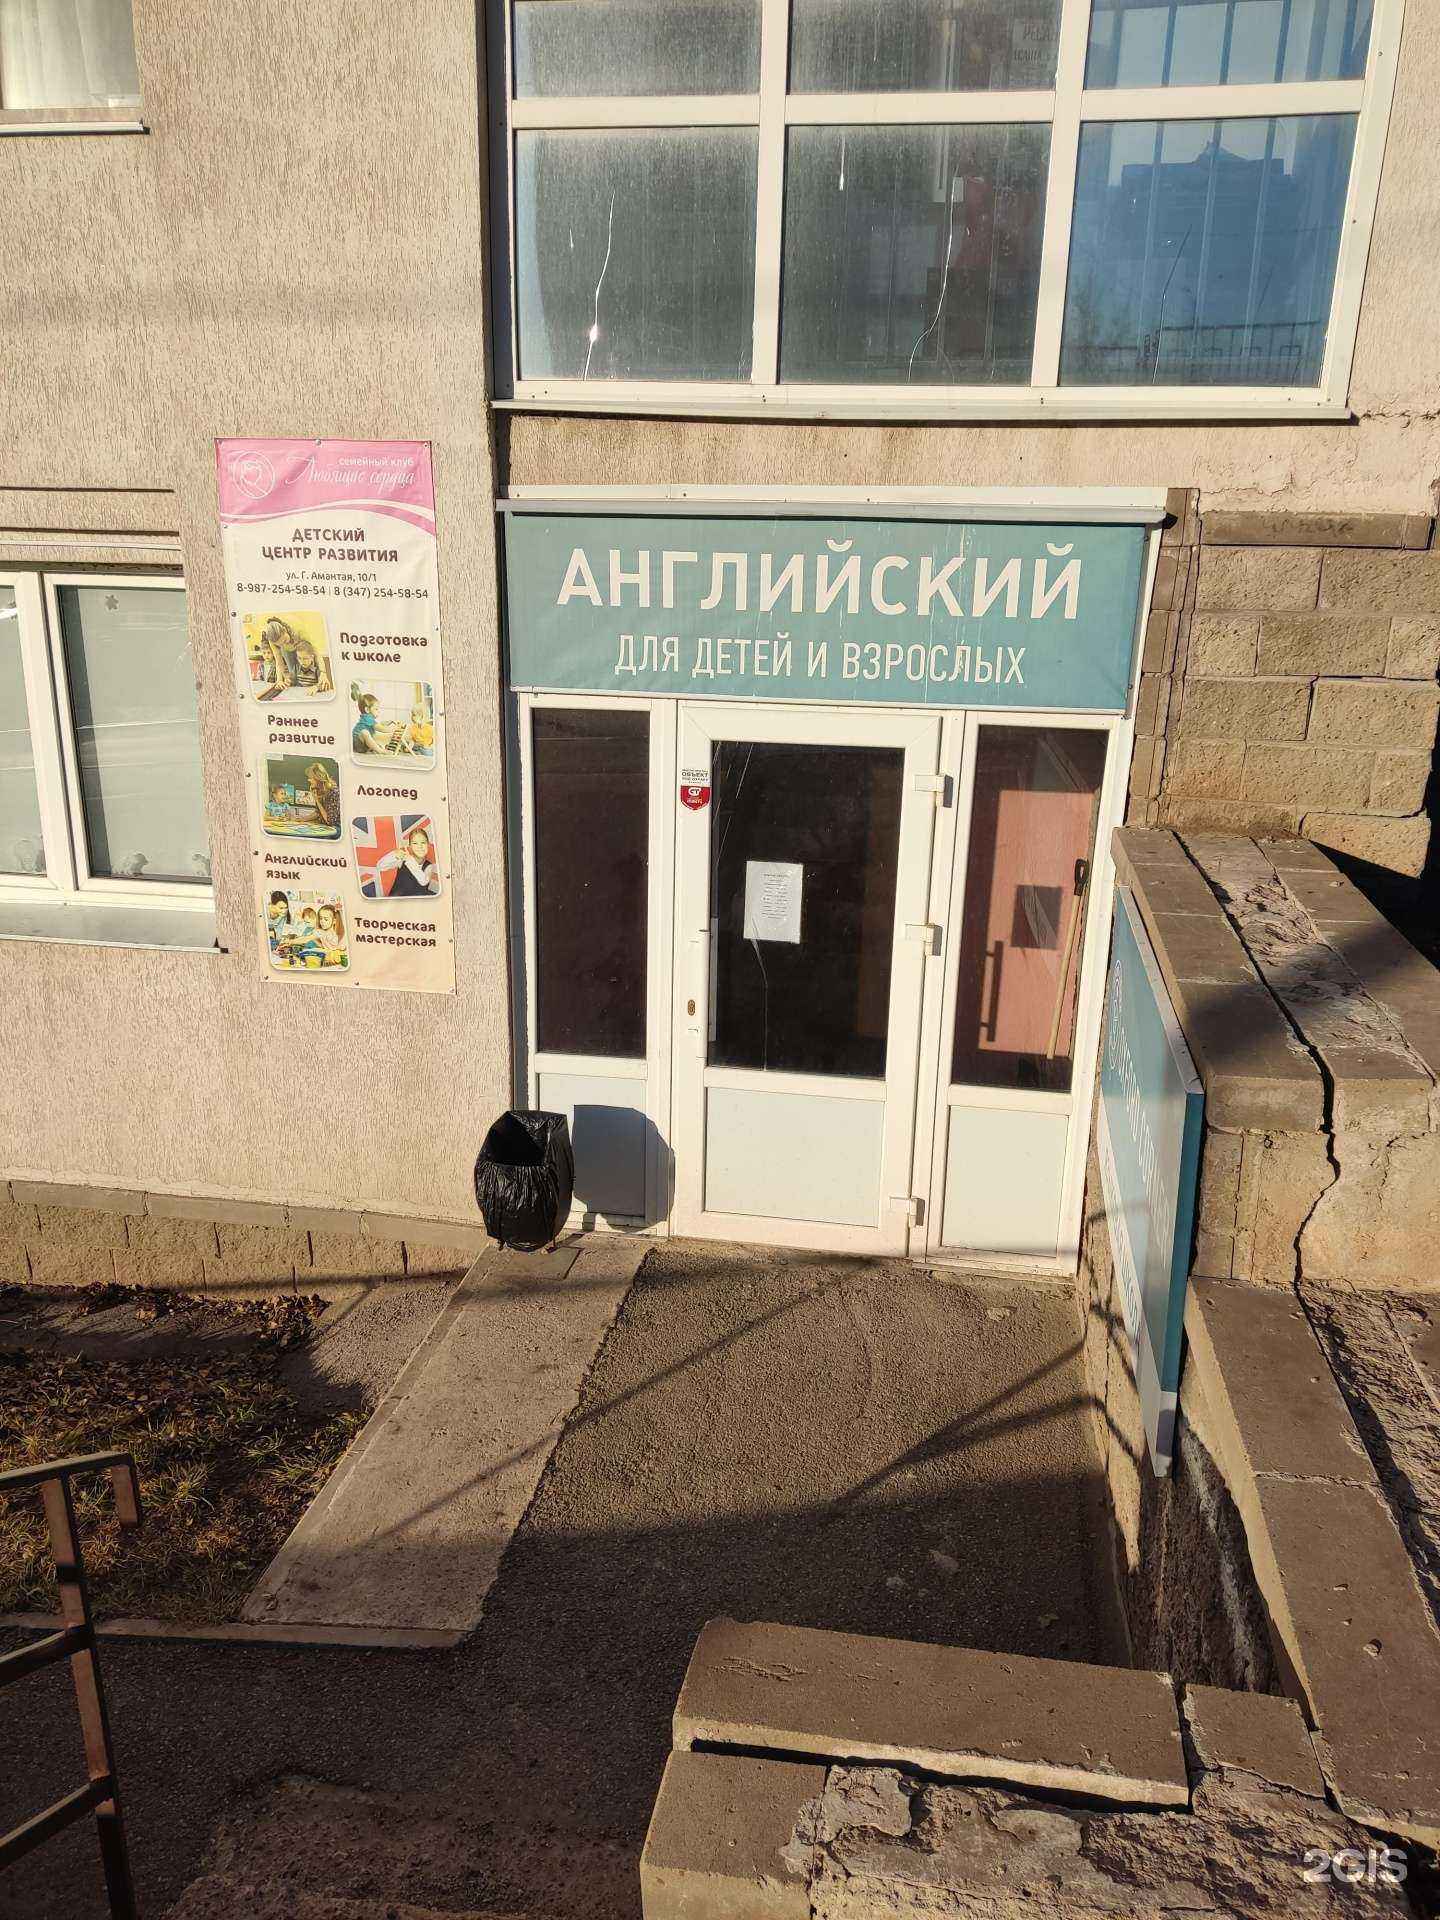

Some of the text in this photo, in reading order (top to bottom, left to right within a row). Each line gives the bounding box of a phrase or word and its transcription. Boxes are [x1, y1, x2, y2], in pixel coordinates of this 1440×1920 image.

[291, 527, 365, 543] ДЕТСКИЙ
[261, 546, 398, 563] ЦЕНТР РАЗВИТИЯ
[286, 570, 377, 583] ул. Г. Амантая, 10/1
[556, 538, 1083, 620] АНГЛИЙСКИЙ
[236, 582, 429, 600] 8-987-254-58-54 8 (347) 254-58-54
[339, 631, 429, 648] Подготовка
[341, 651, 401, 663] к школе
[613, 631, 1026, 684] ДЛЯ ДЕТЕЙ И ВЗРОСЛЫХ
[267, 714, 319, 728] Раннее
[268, 732, 335, 745] развитие
[356, 784, 418, 801] Логопед
[264, 852, 348, 868] Английский
[266, 869, 301, 881] язык
[354, 917, 437, 933] Творческая
[355, 933, 437, 948] мастерская
